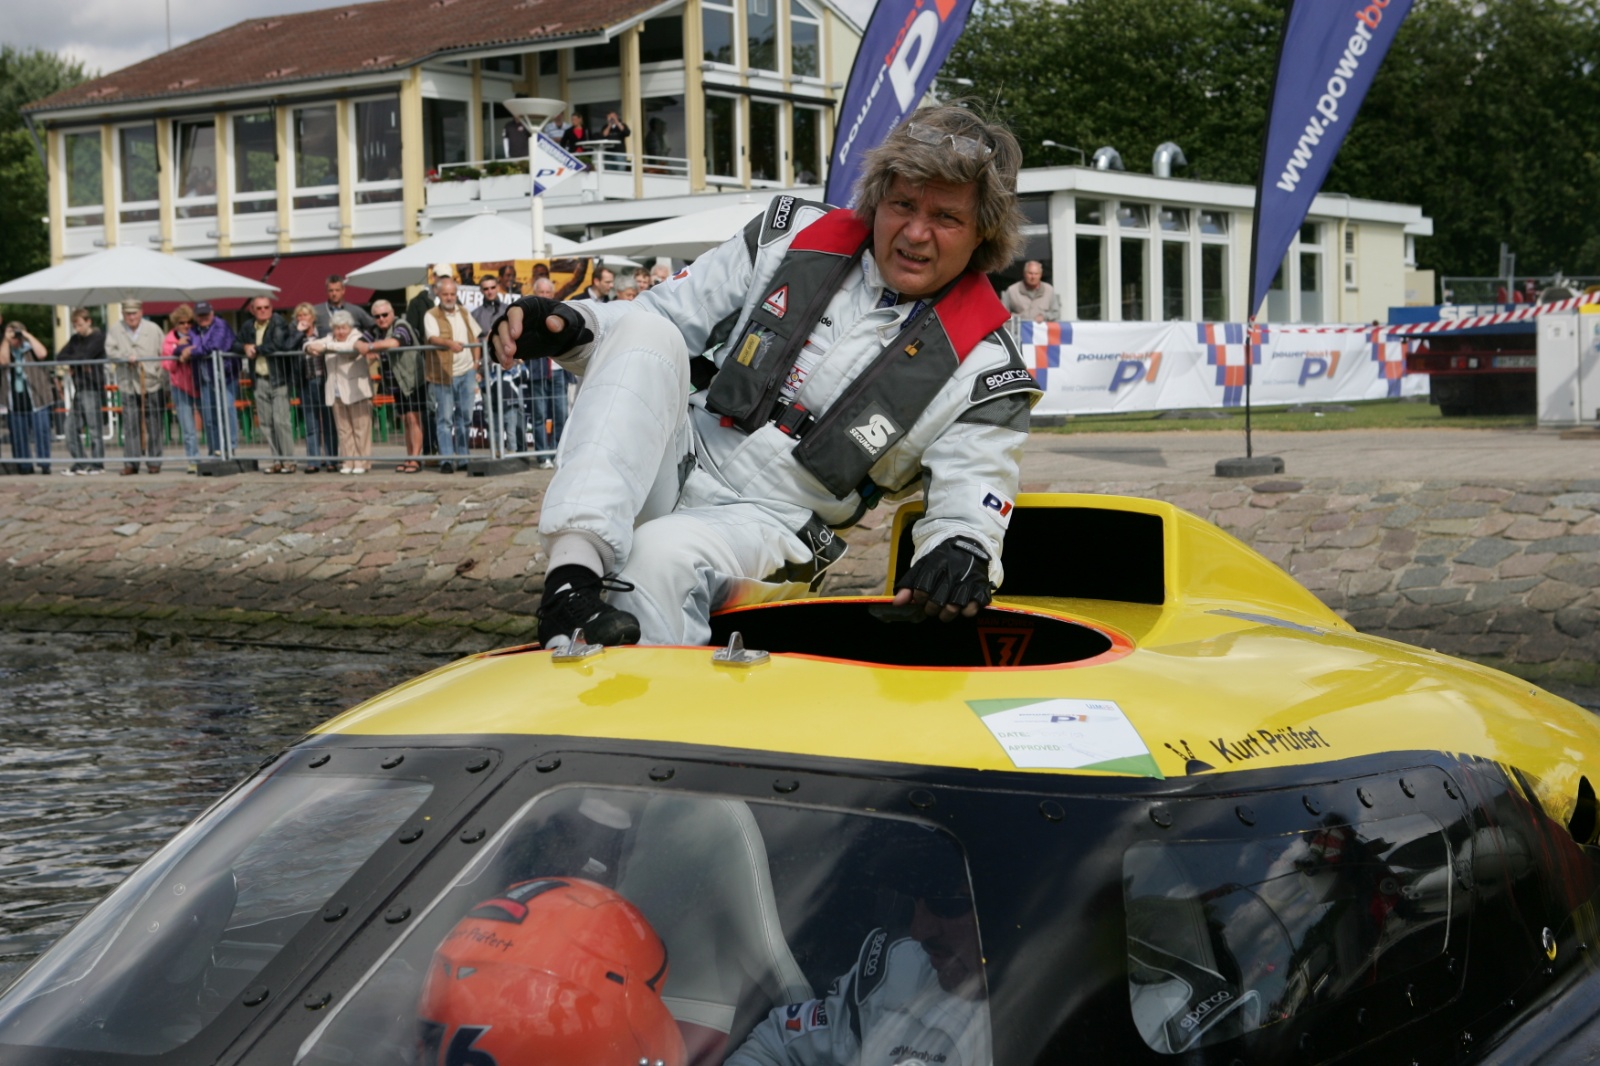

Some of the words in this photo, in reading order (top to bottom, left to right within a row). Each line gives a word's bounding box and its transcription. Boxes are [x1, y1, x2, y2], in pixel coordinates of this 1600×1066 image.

[773, 195, 795, 229] sparco
[986, 369, 1032, 390] sparco
[849, 427, 878, 456] SECUMAR
[998, 731, 1030, 739] DATE:
[1008, 744, 1064, 752] APPROVED:
[1209, 733, 1270, 764] Kurt
[1256, 725, 1331, 753] Prüfert
[864, 932, 888, 977] sparco
[1180, 990, 1233, 1032] sparco
